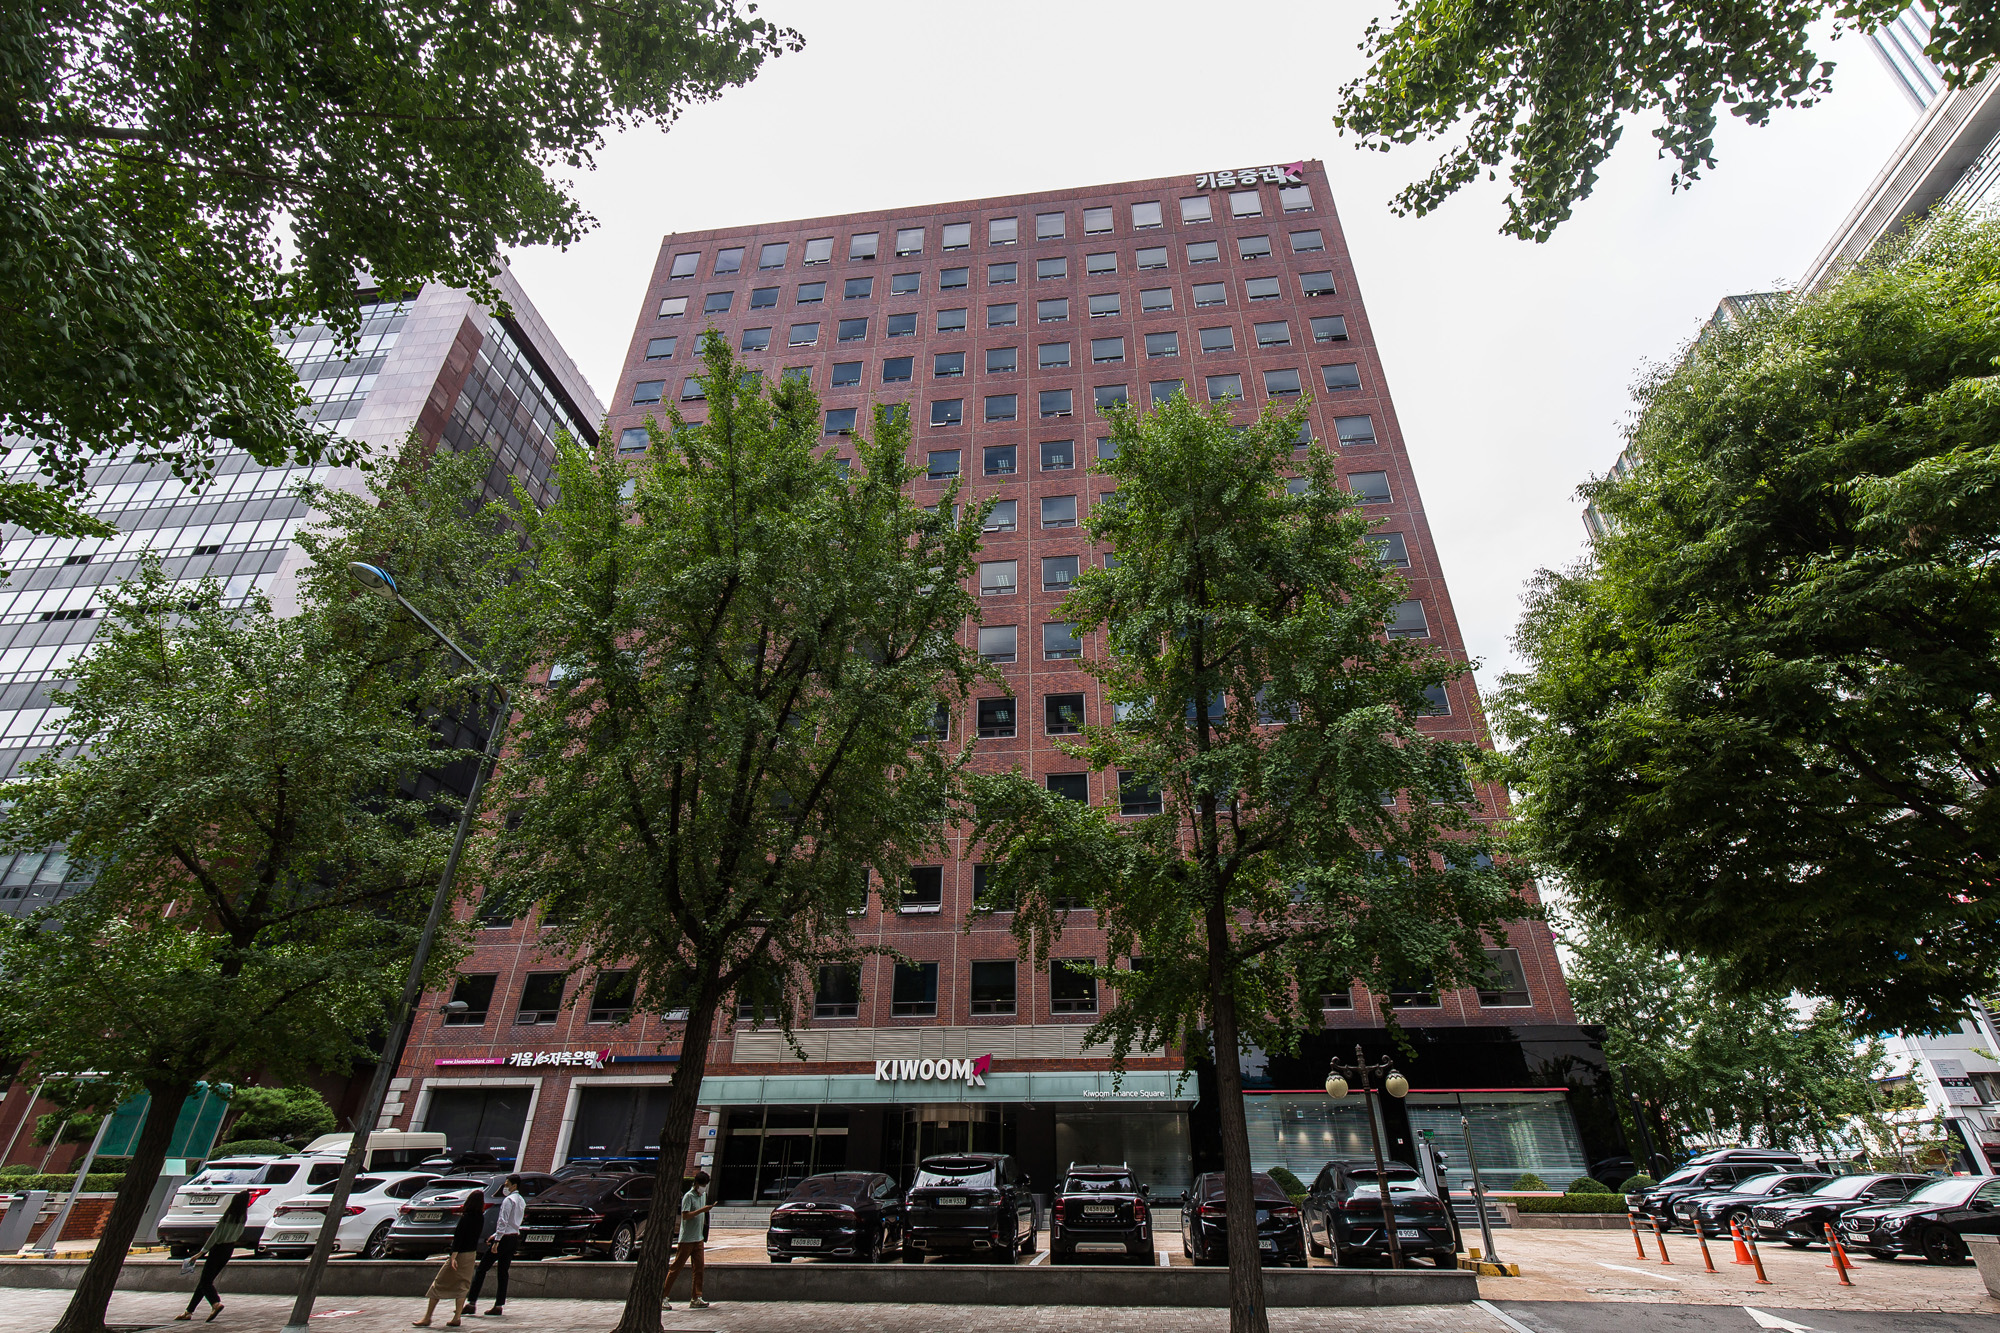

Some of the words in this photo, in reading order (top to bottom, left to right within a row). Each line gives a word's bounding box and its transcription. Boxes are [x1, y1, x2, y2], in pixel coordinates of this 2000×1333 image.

[1195, 165, 1285, 191] 키움증권
[875, 1058, 970, 1081] KIWOOM
[1083, 1090, 1110, 1098] Kiwoom
[1140, 1089, 1165, 1099] Square
